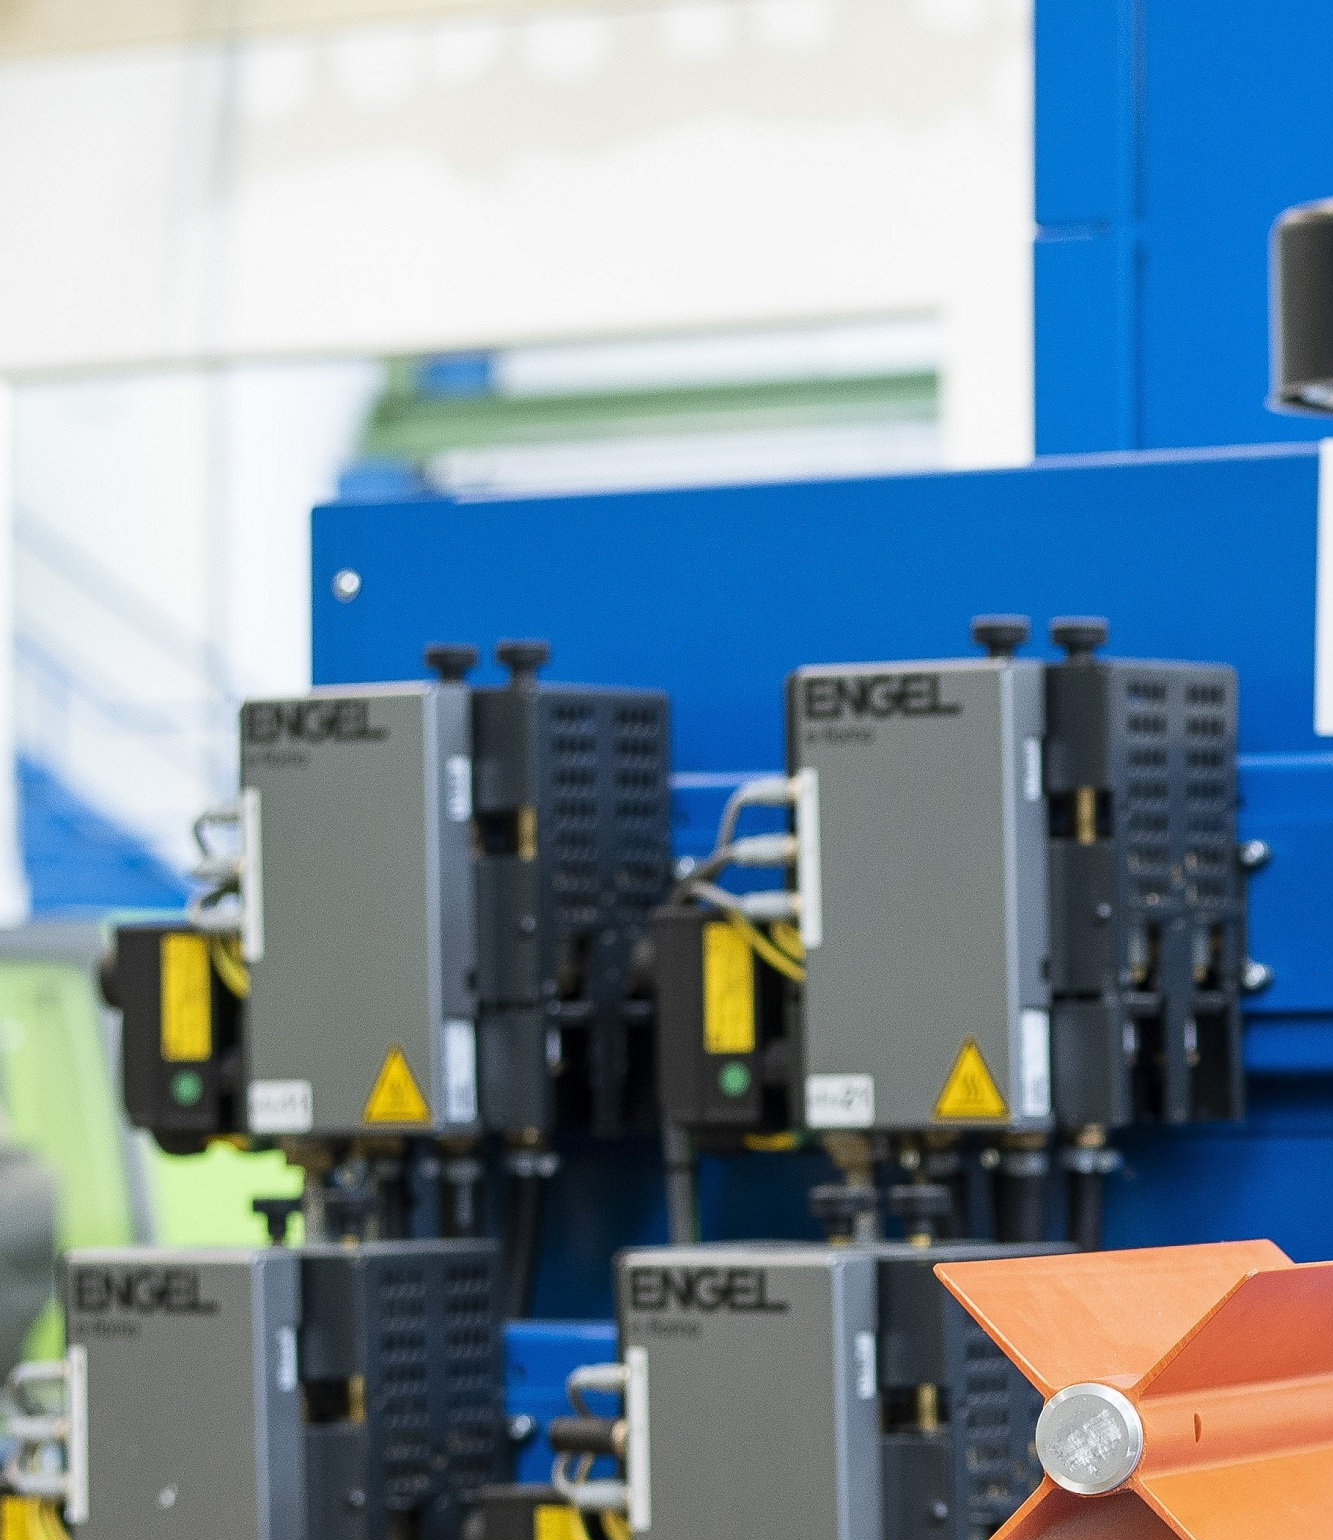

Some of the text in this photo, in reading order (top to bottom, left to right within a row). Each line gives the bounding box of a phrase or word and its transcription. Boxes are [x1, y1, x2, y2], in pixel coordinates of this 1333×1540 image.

[805, 674, 963, 719] ENGEL
[246, 700, 389, 744] ENGEL
[75, 1268, 221, 1314] ENGEL
[631, 1266, 791, 1312] ENGEL
